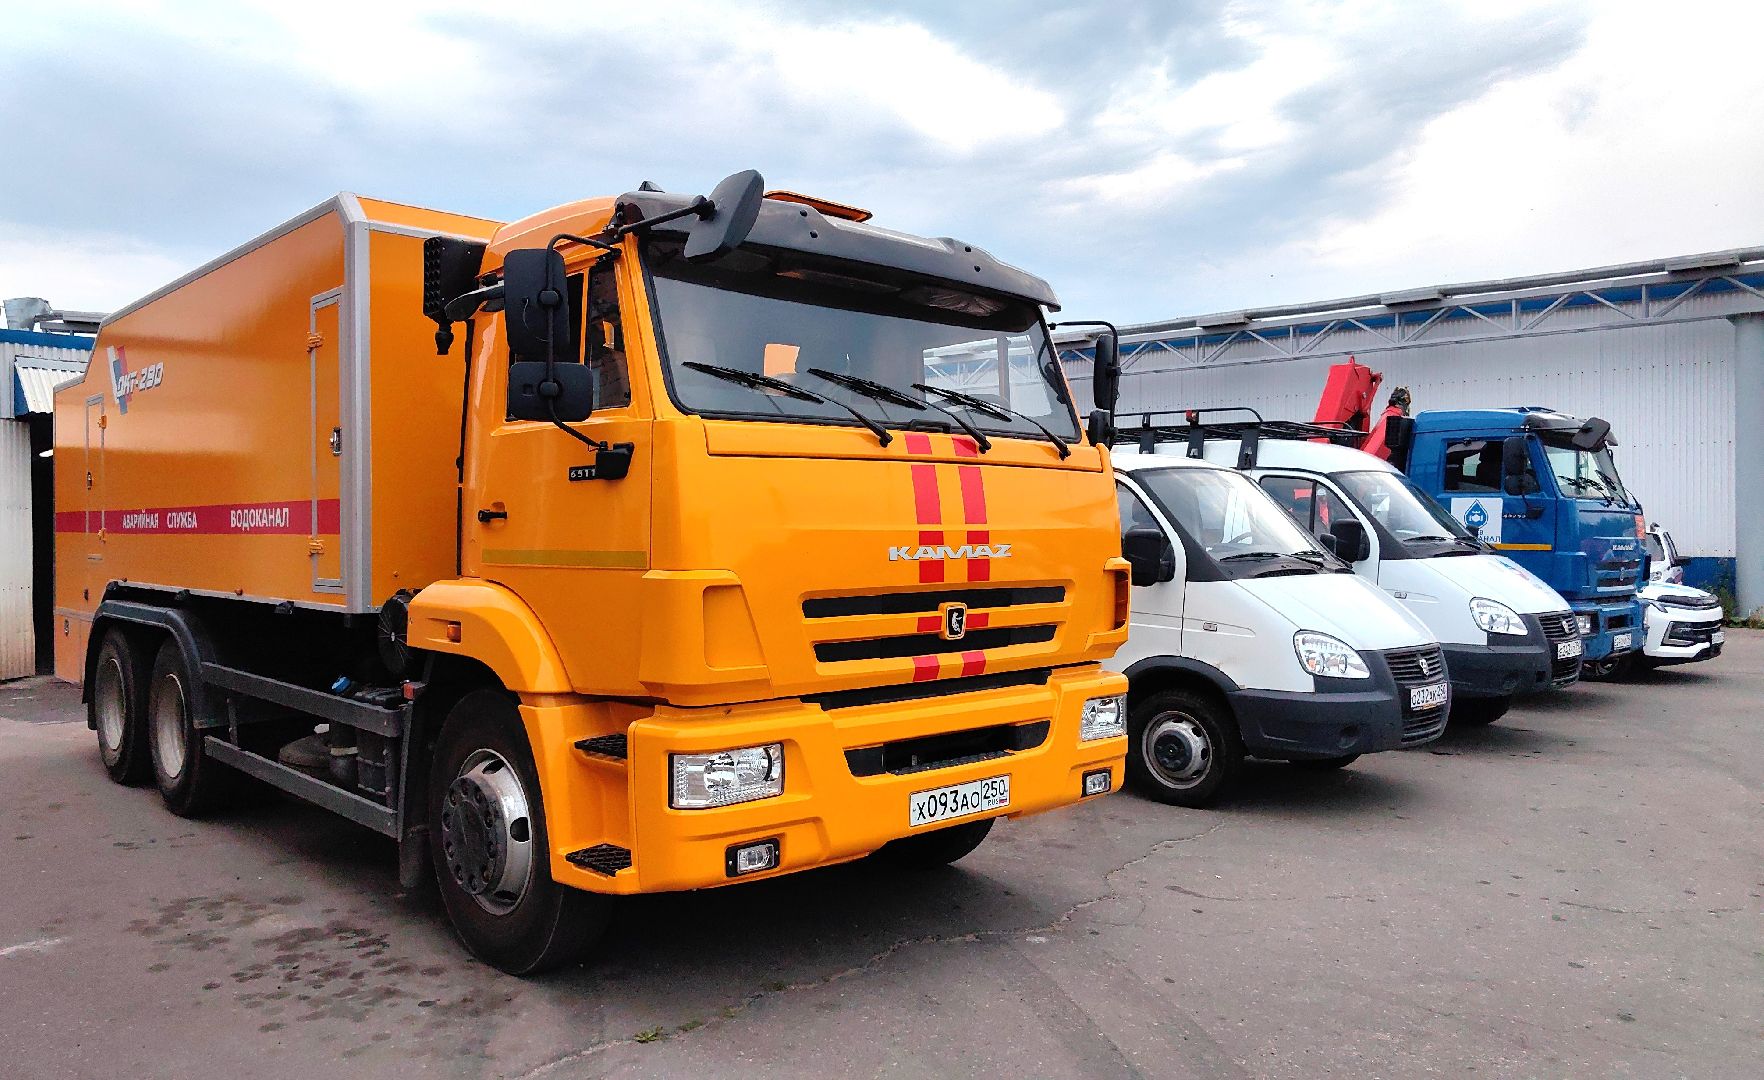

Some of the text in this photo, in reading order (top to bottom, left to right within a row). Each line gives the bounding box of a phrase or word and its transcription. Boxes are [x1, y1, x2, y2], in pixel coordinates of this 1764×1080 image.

[570, 468, 596, 478] 6511
[122, 508, 289, 531] АВАРИЙНАЯ СЛУЖБА ВОДОКАНАЛ
[889, 544, 1012, 561] KAMAZ
[982, 779, 1006, 800] 250
